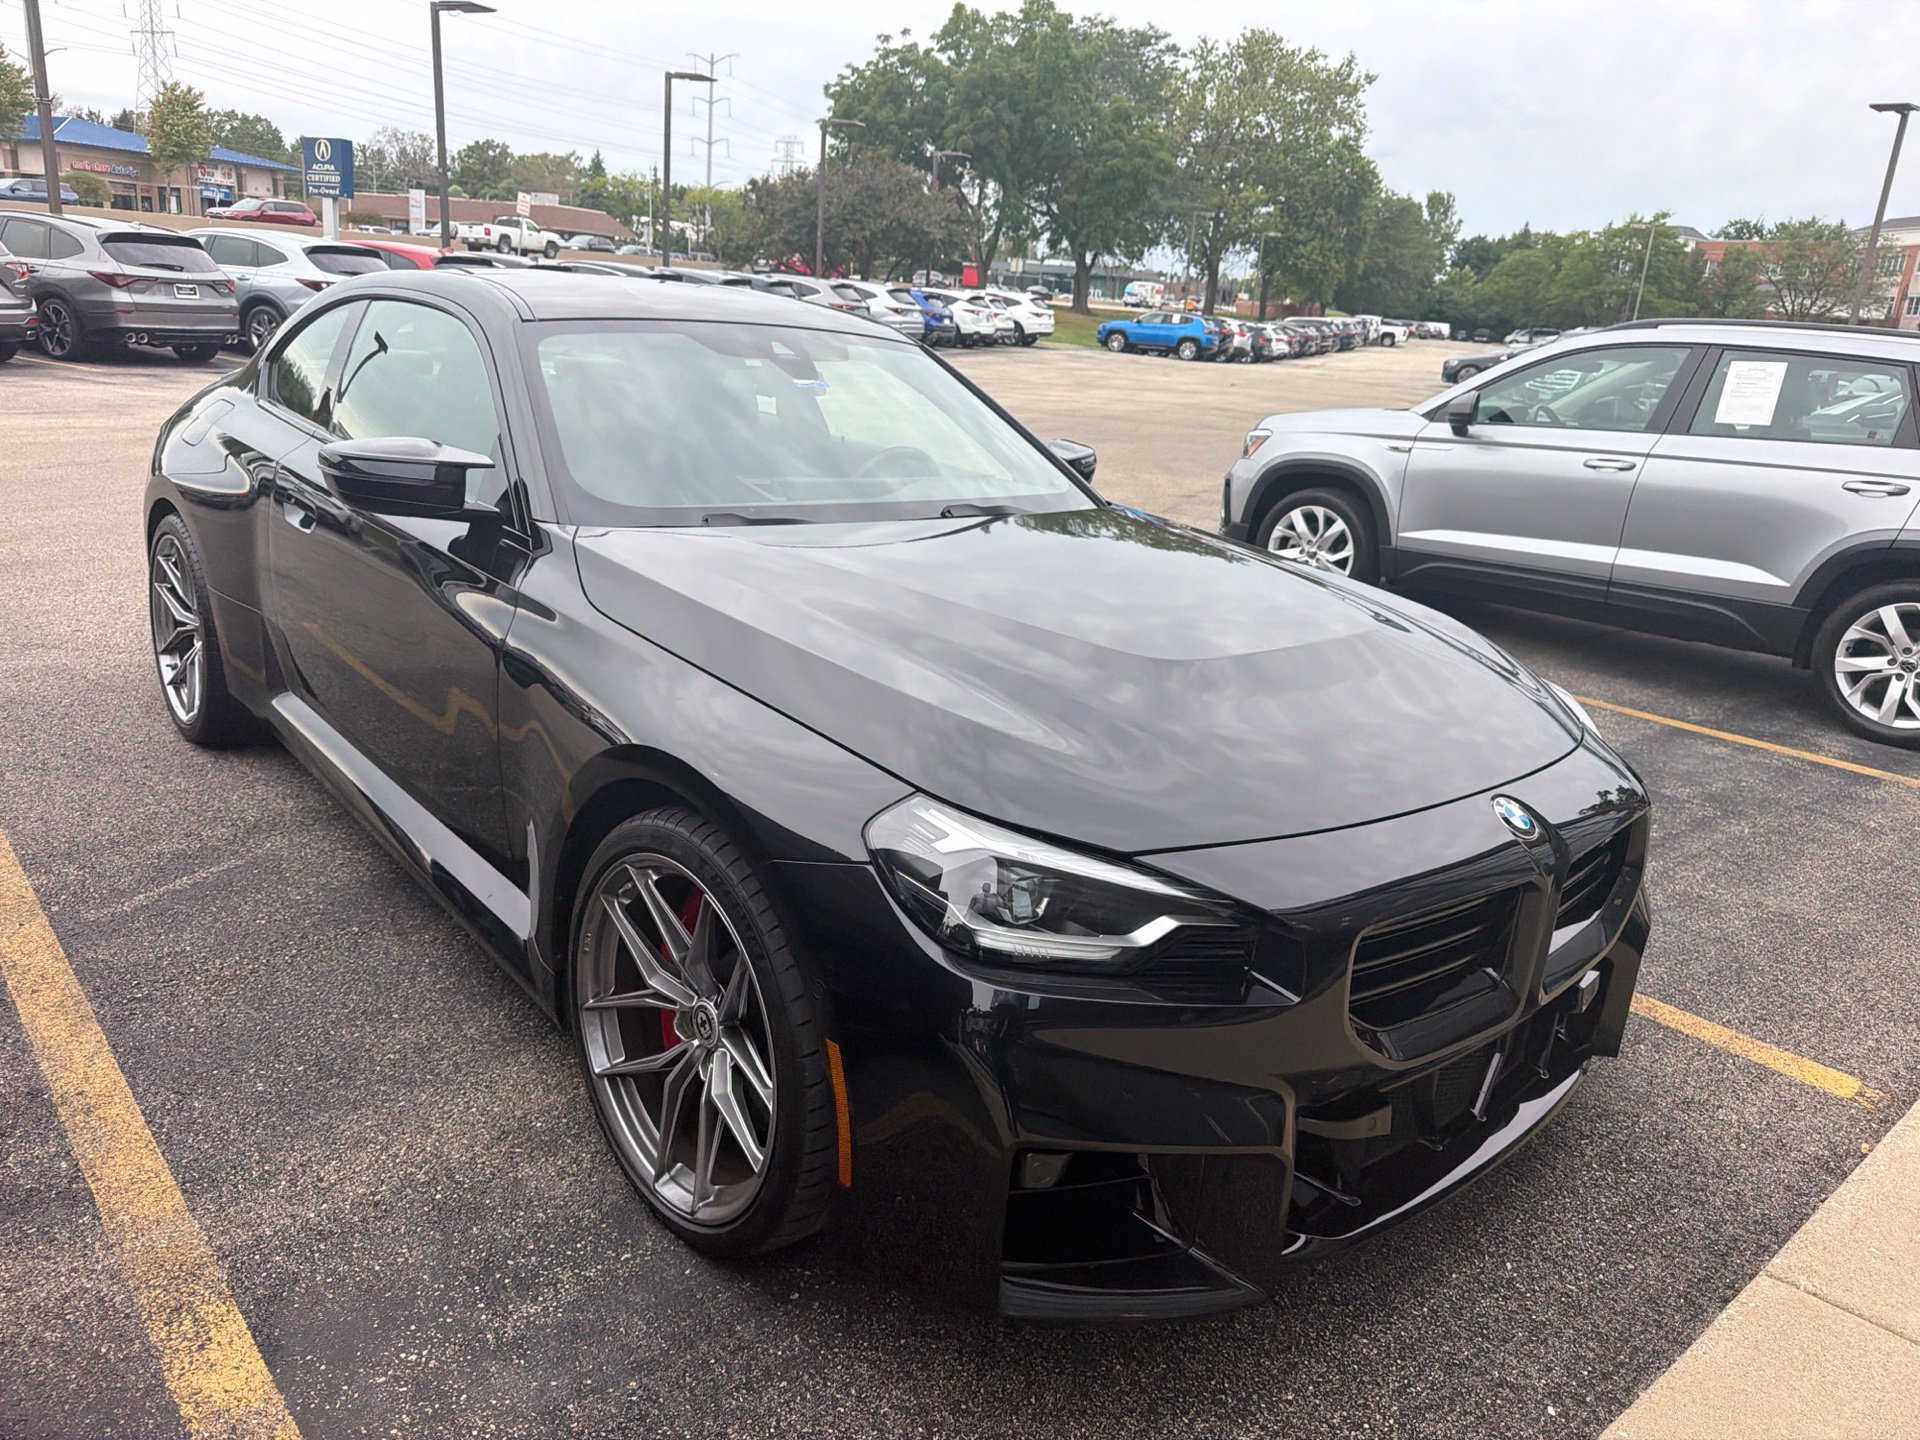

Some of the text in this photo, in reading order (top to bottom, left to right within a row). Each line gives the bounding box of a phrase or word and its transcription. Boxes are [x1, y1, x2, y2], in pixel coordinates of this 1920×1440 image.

[312, 163, 335, 171] ACURA
[306, 174, 341, 183] CERTIFIED
[308, 186, 340, 195] Pre-Owned
